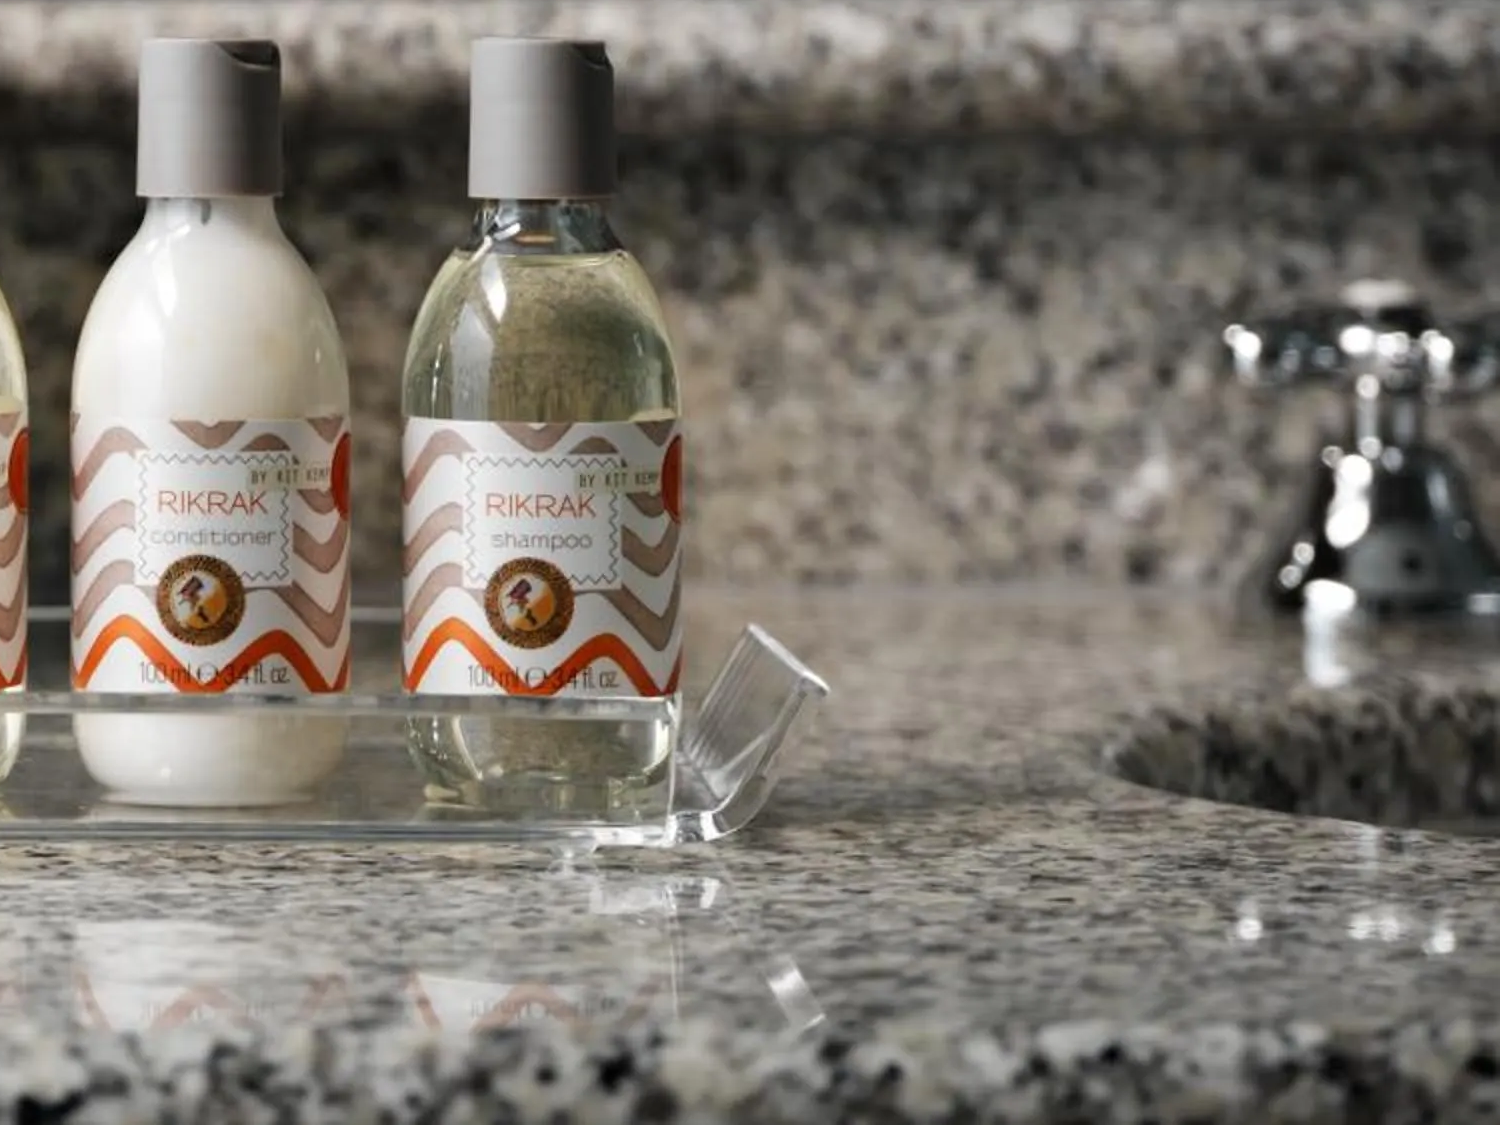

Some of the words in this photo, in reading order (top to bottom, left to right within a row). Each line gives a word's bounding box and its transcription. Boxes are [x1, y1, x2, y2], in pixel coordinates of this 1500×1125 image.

[158, 490, 268, 514] RIKRAK
[485, 493, 597, 518] RIKRAK
[150, 528, 277, 546] conditioner
[491, 531, 594, 552] shampoo
[140, 661, 167, 684] 100
[171, 660, 191, 684] ml
[468, 665, 495, 687] 100
[499, 666, 519, 687] ml
